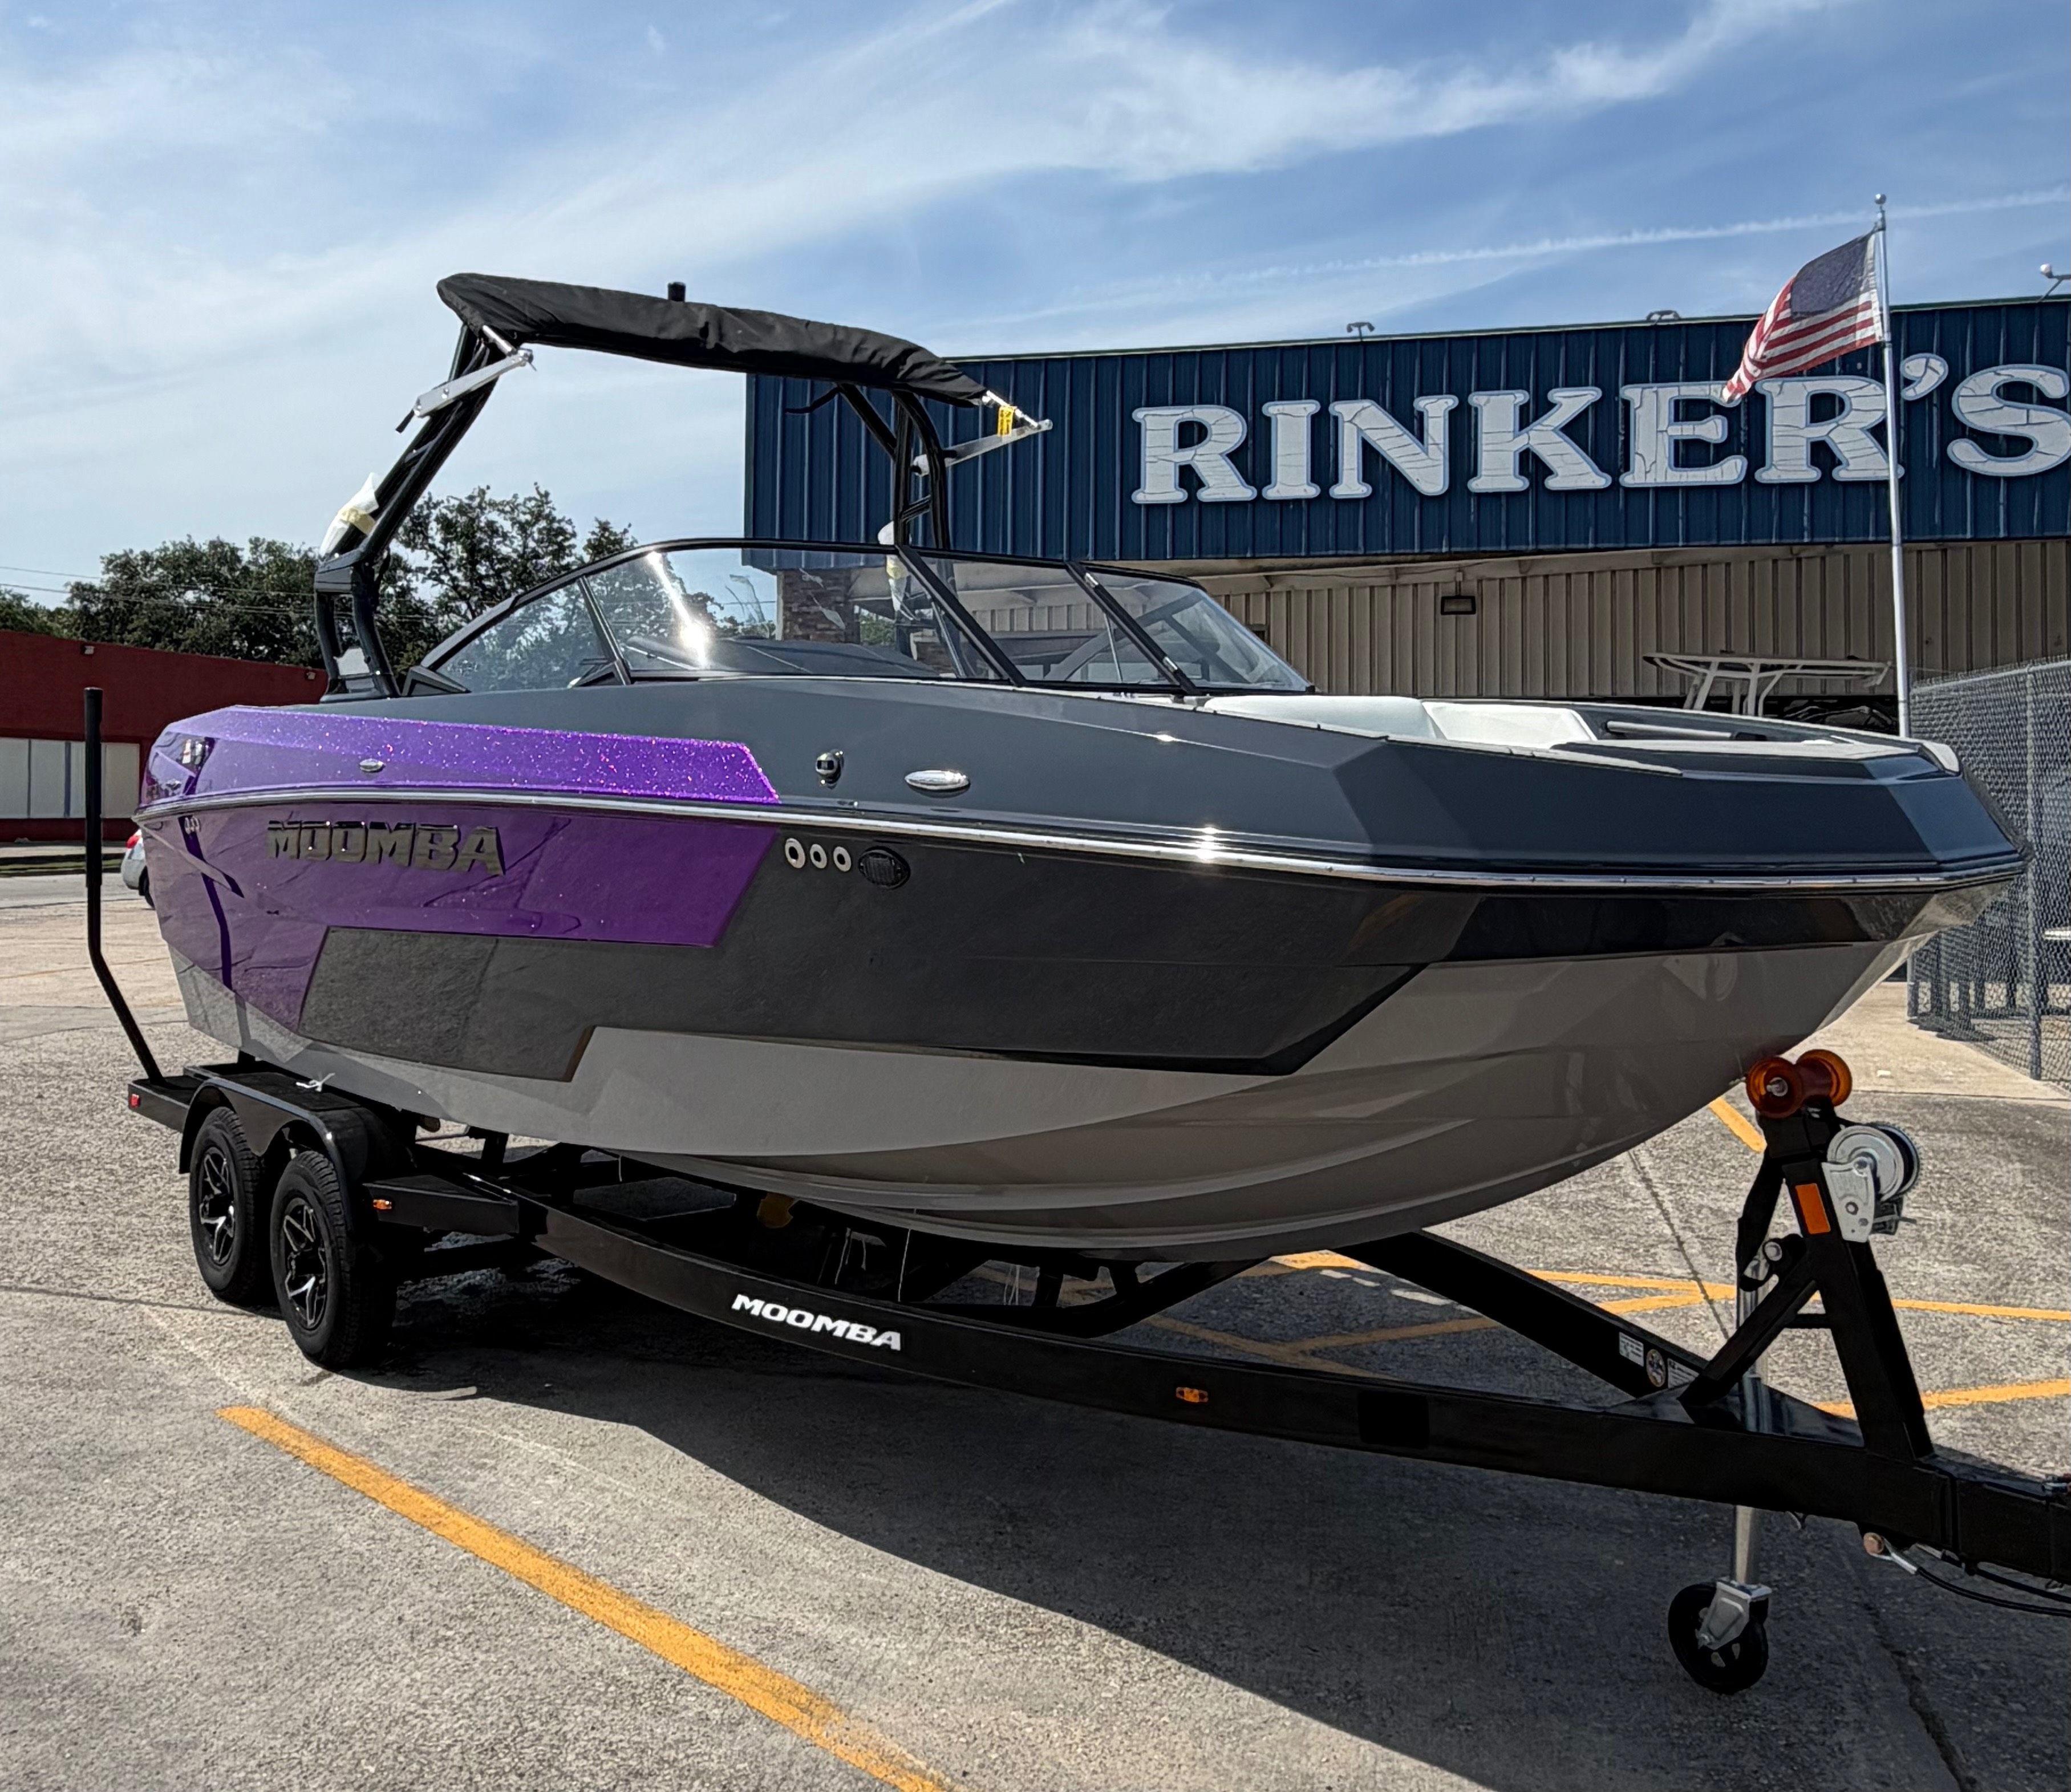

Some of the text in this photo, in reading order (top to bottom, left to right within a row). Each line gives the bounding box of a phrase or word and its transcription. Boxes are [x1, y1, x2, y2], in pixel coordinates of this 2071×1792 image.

[1130, 352, 2071, 504] RINKER'S
[267, 820, 506, 875] MOOMBA
[731, 1294, 902, 1351] MOOMBA
